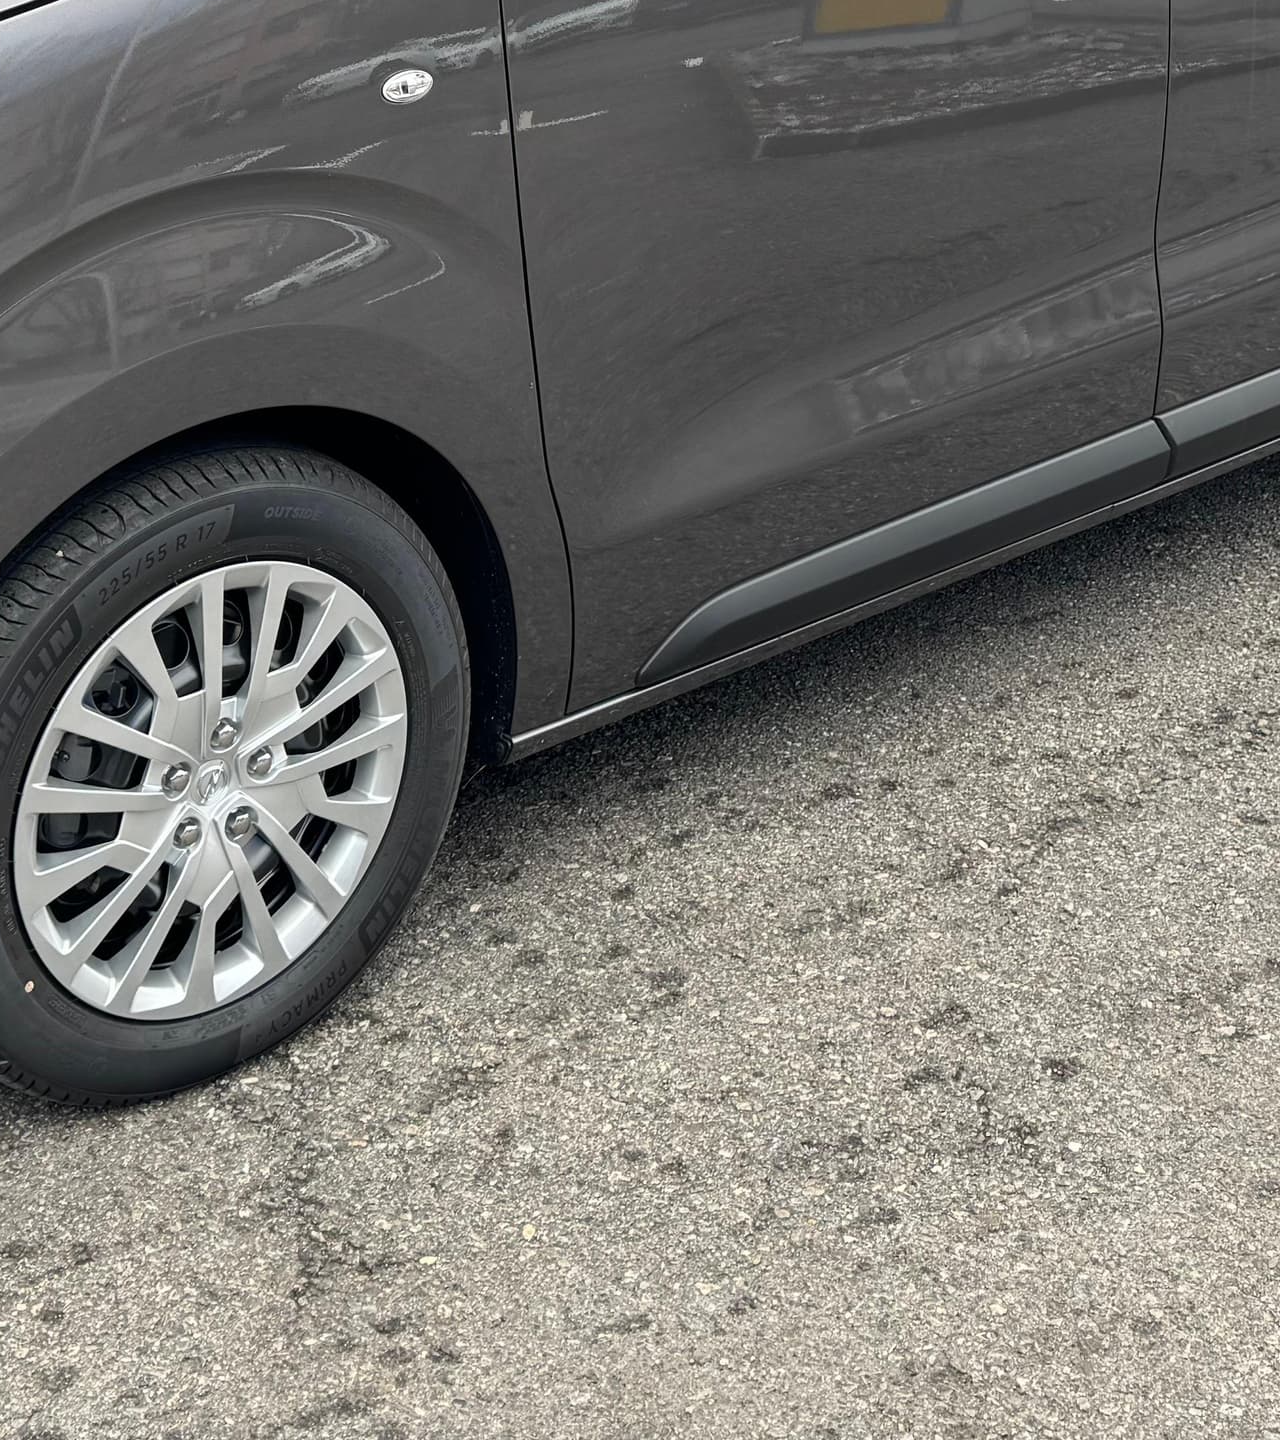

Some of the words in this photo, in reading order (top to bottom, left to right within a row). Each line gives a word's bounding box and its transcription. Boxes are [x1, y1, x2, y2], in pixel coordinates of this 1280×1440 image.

[97, 542, 168, 606] 225/55
[175, 533, 188, 552] R
[198, 521, 218, 542] 17
